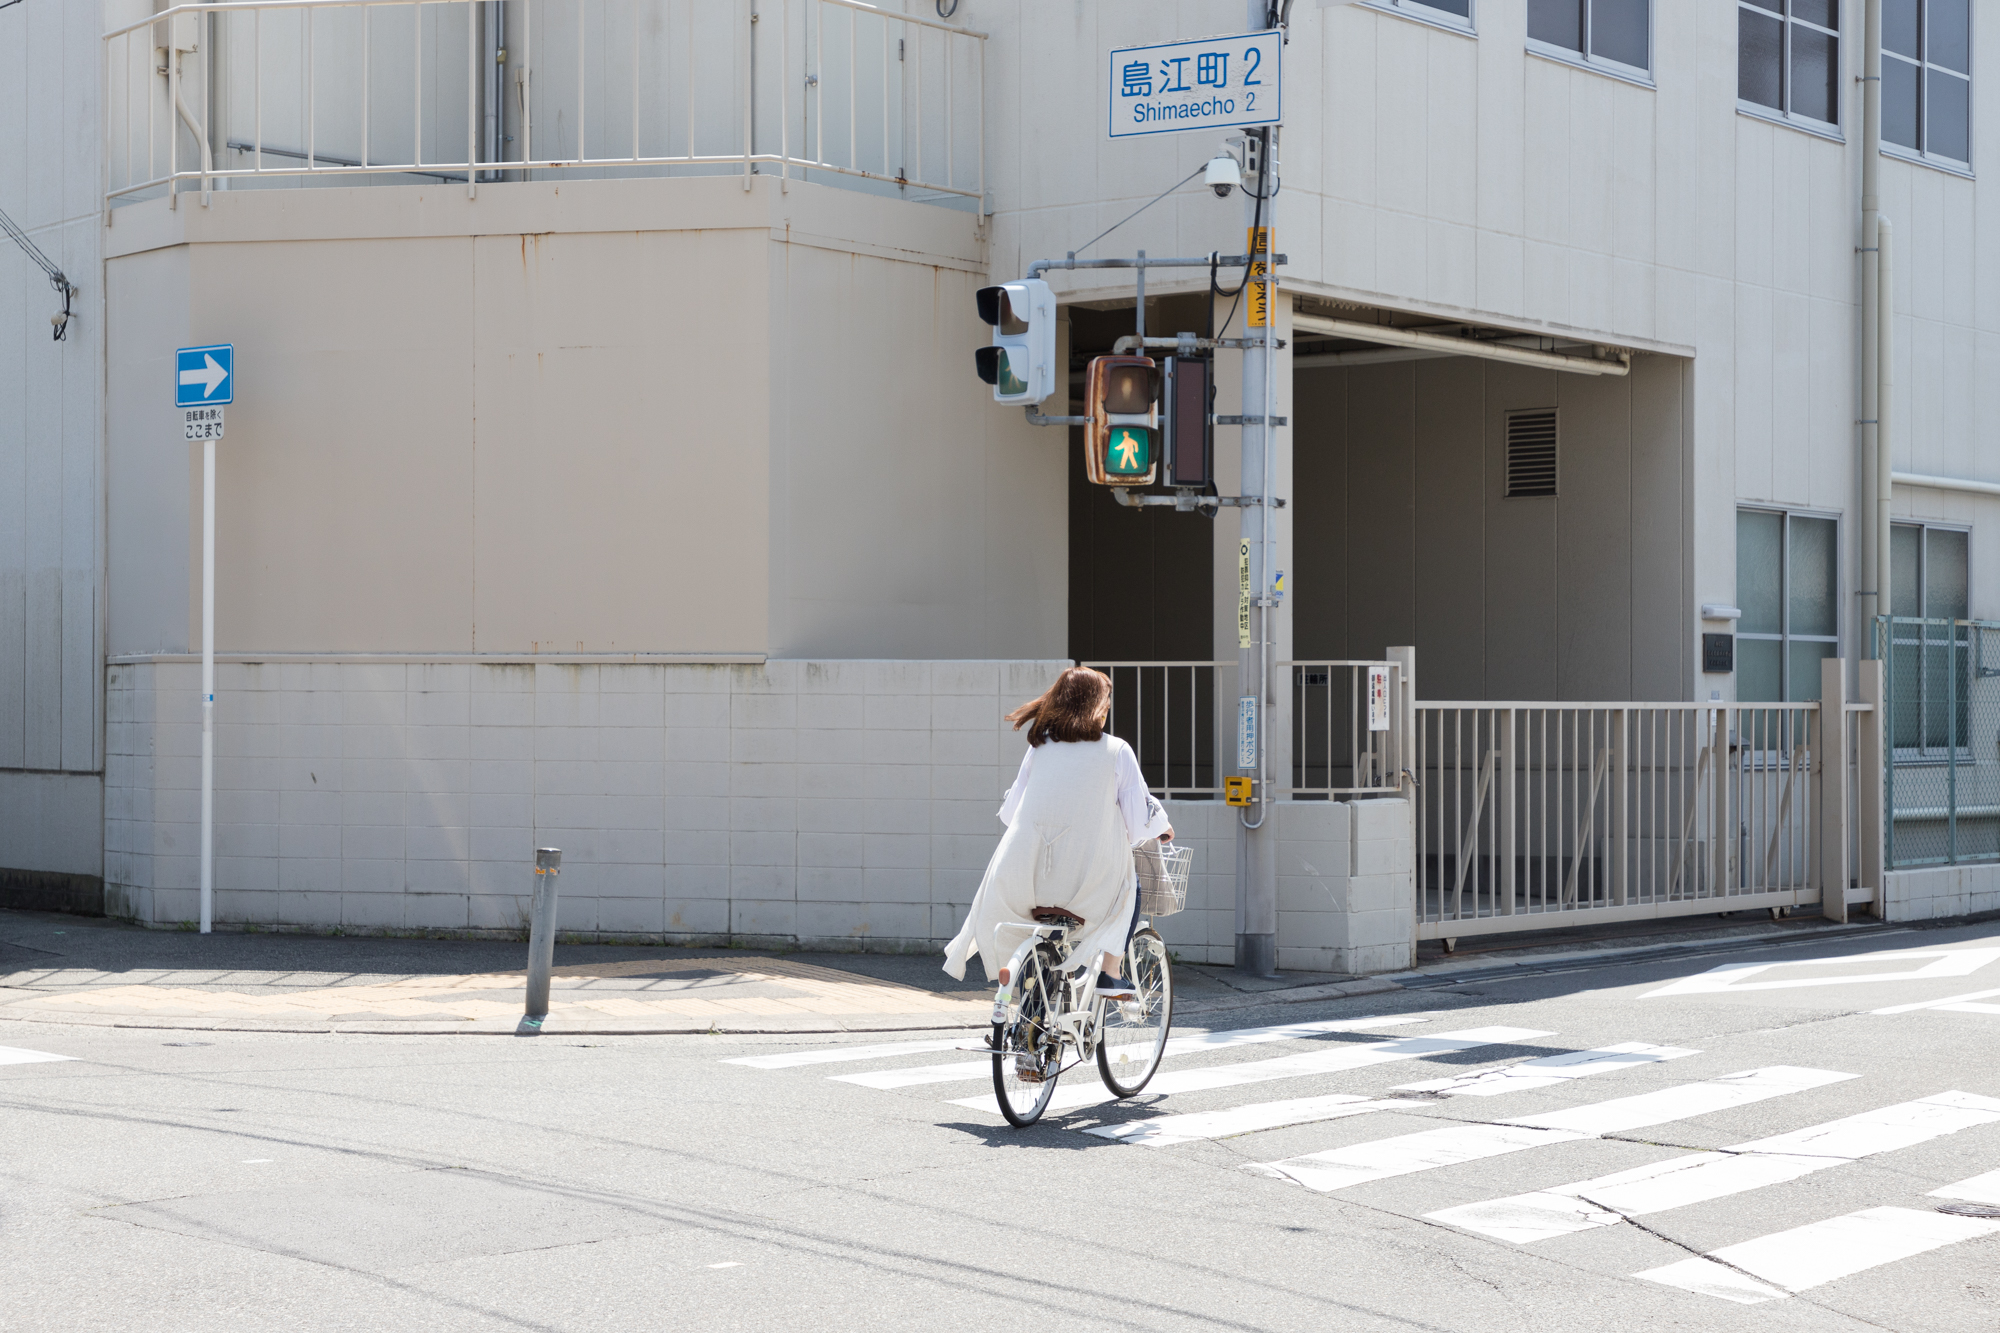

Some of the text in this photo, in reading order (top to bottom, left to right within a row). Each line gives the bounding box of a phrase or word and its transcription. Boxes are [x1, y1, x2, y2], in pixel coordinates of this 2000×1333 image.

[1121, 47, 1262, 97] 島江町 2
[1133, 92, 1256, 123] Shimaecho 2
[186, 409, 222, 422] 自転車を除く
[186, 422, 222, 439] ここまで
[1246, 700, 1254, 765] 歩行者用押ボタン
